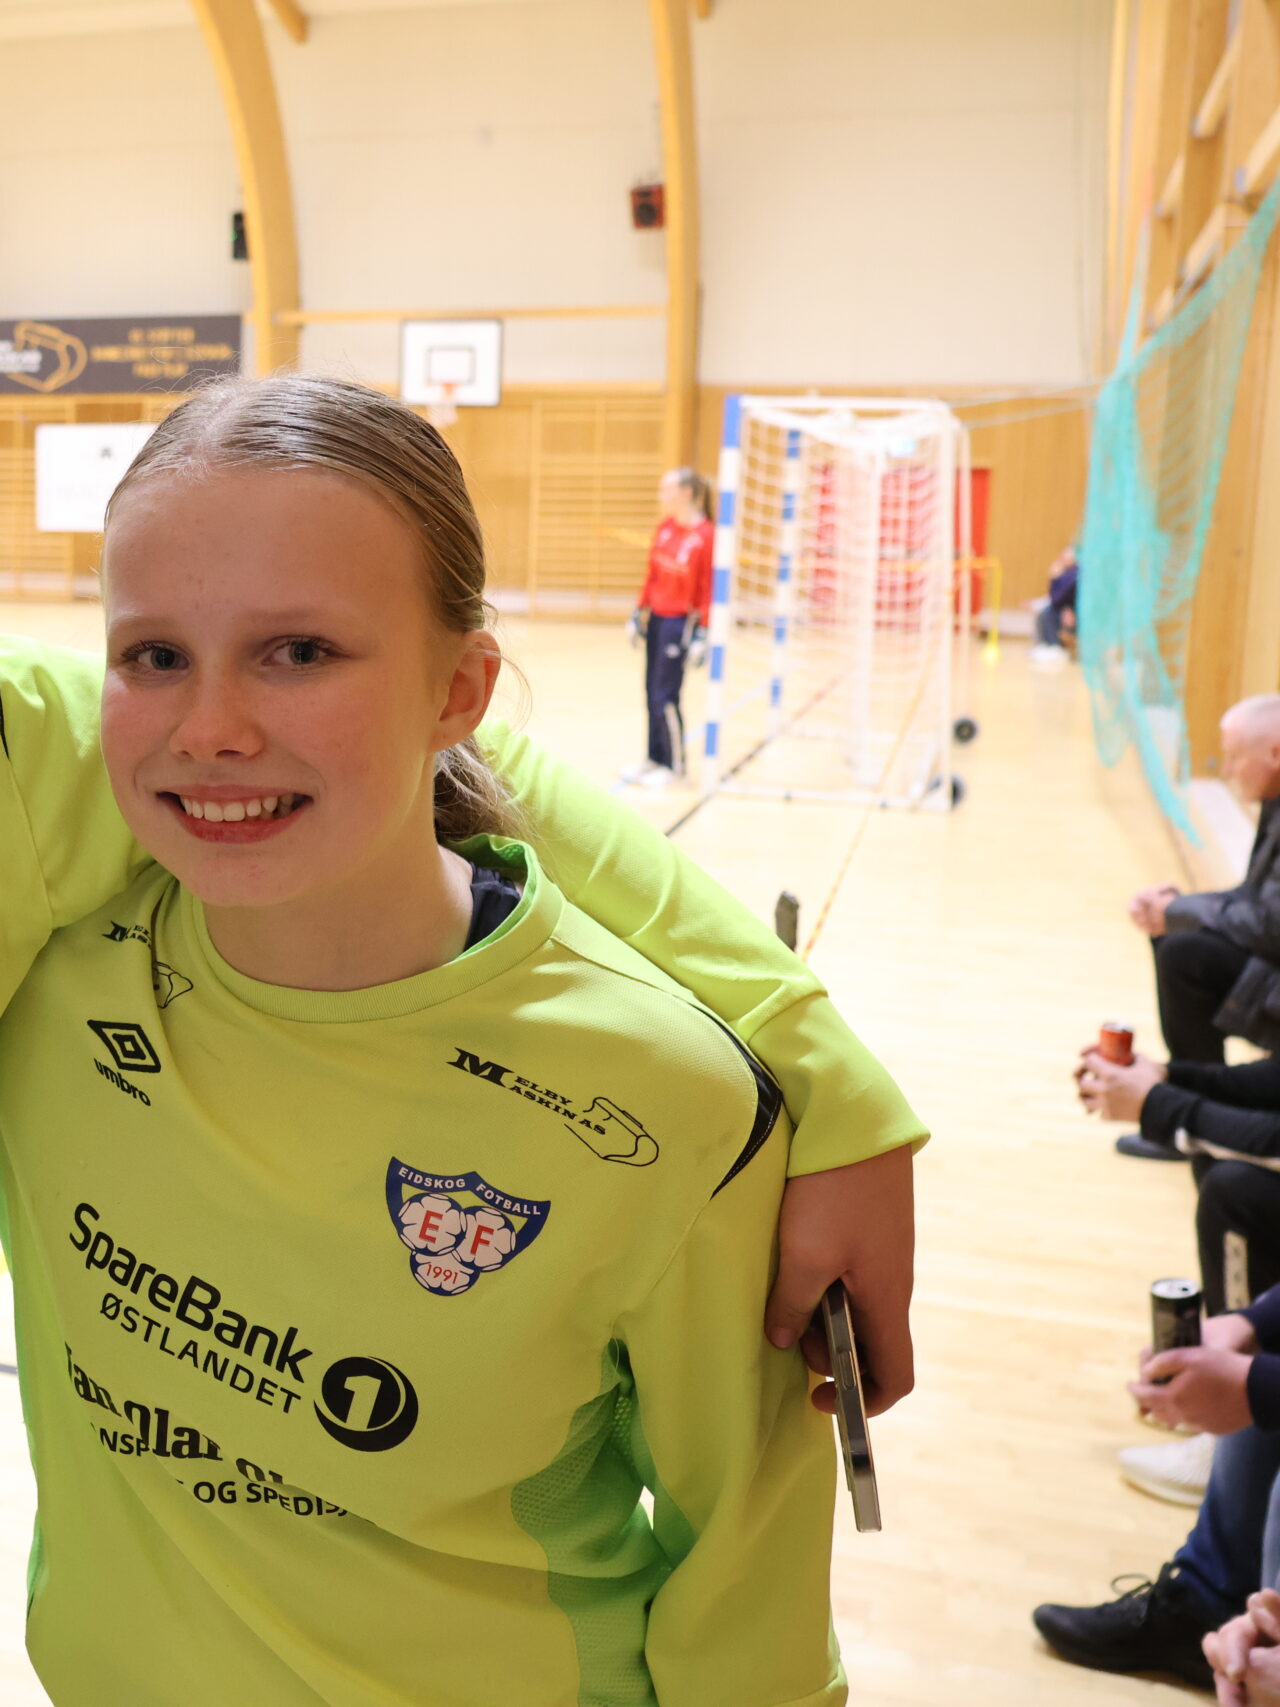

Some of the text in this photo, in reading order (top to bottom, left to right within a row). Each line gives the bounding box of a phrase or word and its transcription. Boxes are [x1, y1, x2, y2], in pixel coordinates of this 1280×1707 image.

[93, 1057, 151, 1107] umbro
[579, 1117, 607, 1135] AS
[398, 1166, 541, 1216] EIDSKOG FOTBALL
[418, 1209, 495, 1256] E F
[425, 1263, 459, 1285] 1991
[69, 1202, 382, 1430] SpareBank 1
[99, 1292, 302, 1414] ØSTLANDET
[193, 1480, 237, 1504] OG
